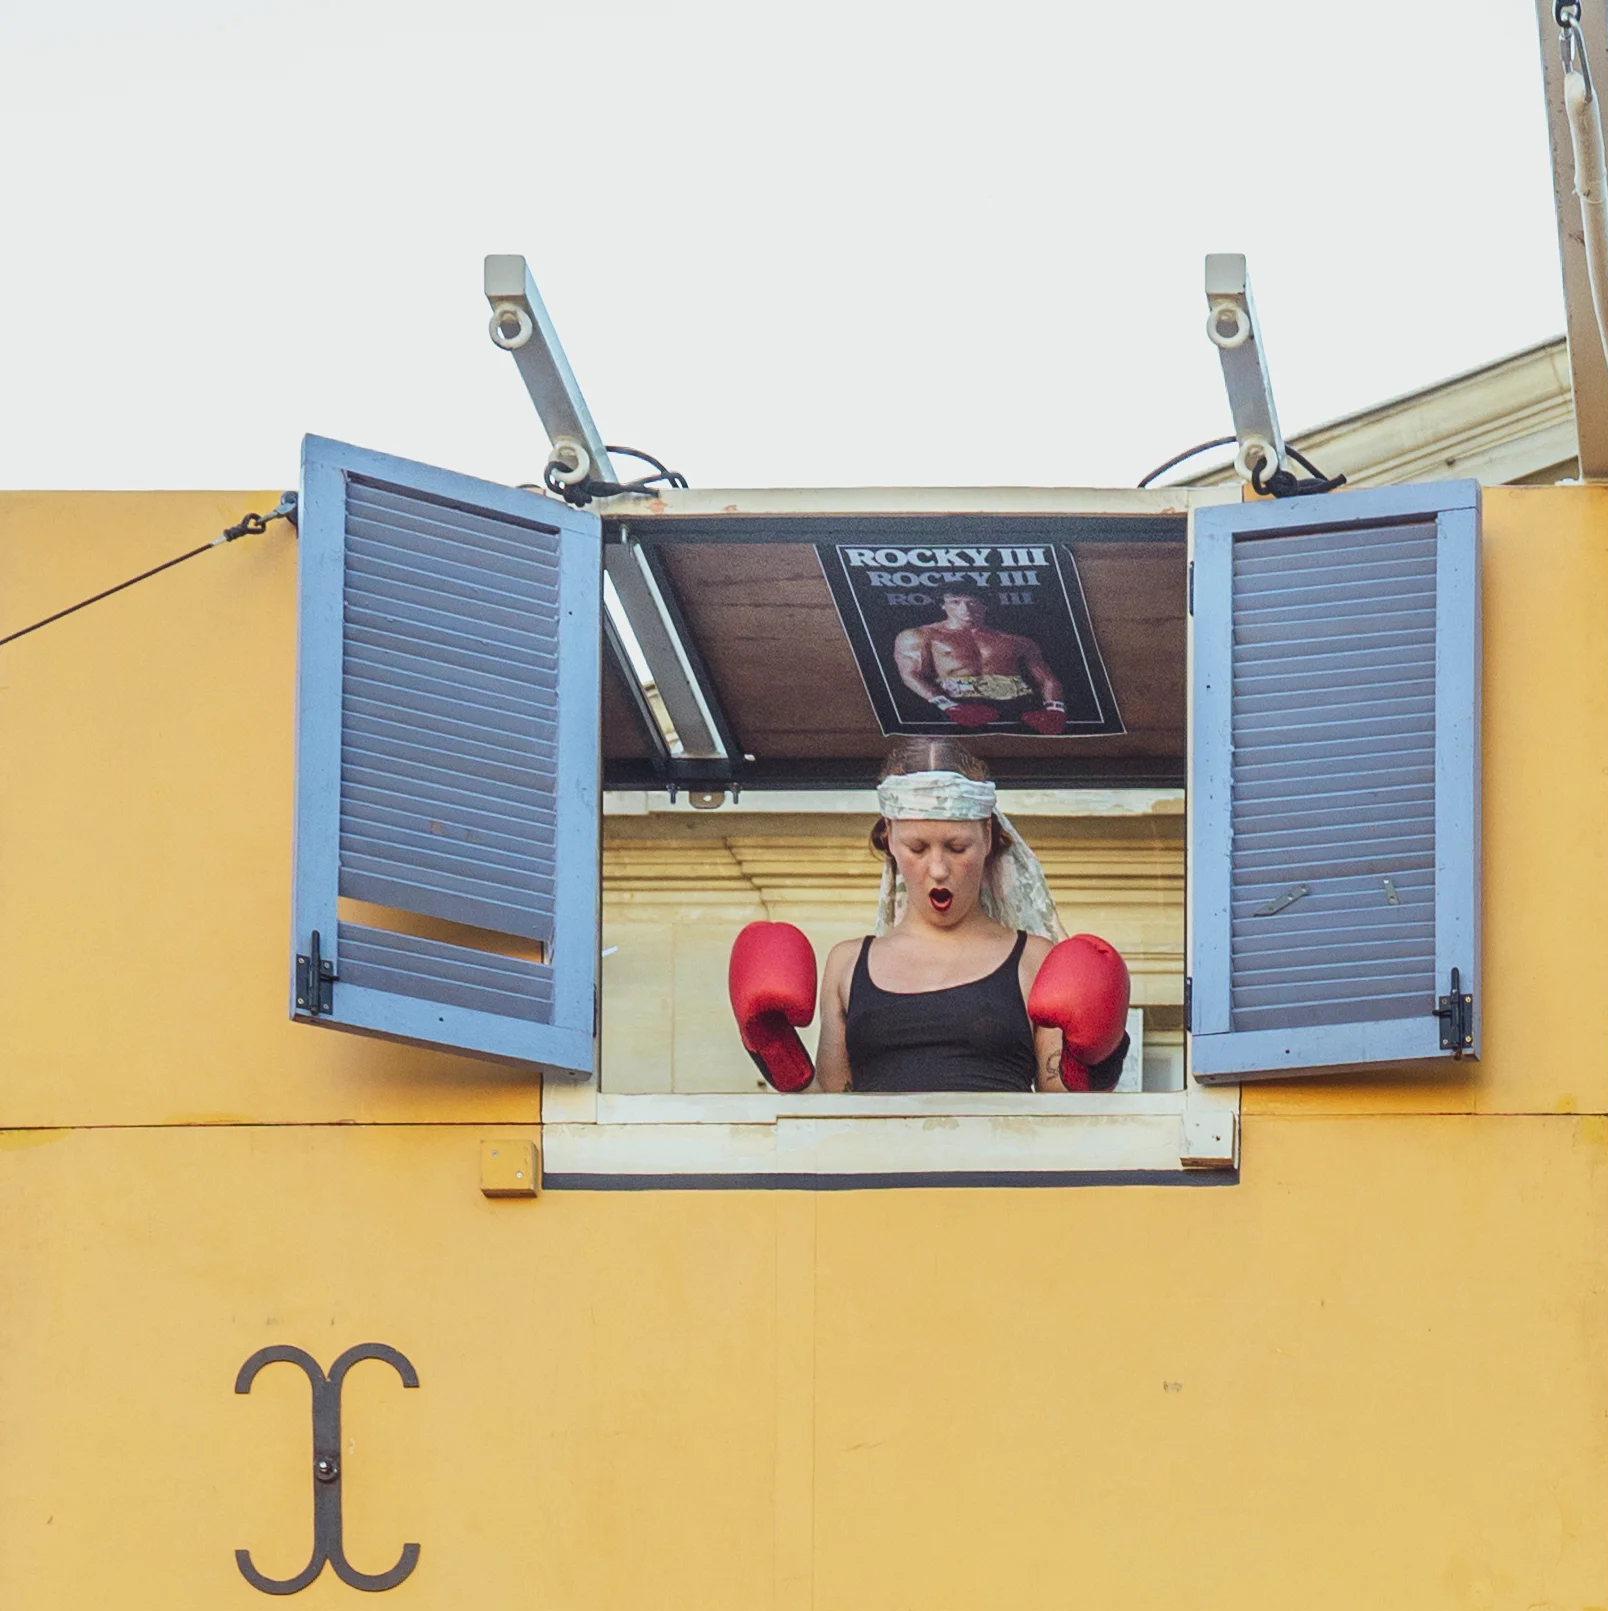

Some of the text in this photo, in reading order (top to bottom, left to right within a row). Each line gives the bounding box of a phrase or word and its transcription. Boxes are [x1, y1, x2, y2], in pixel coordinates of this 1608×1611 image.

[845, 547, 1050, 568] ROCKY III
[866, 570, 1041, 588] ROCKY III
